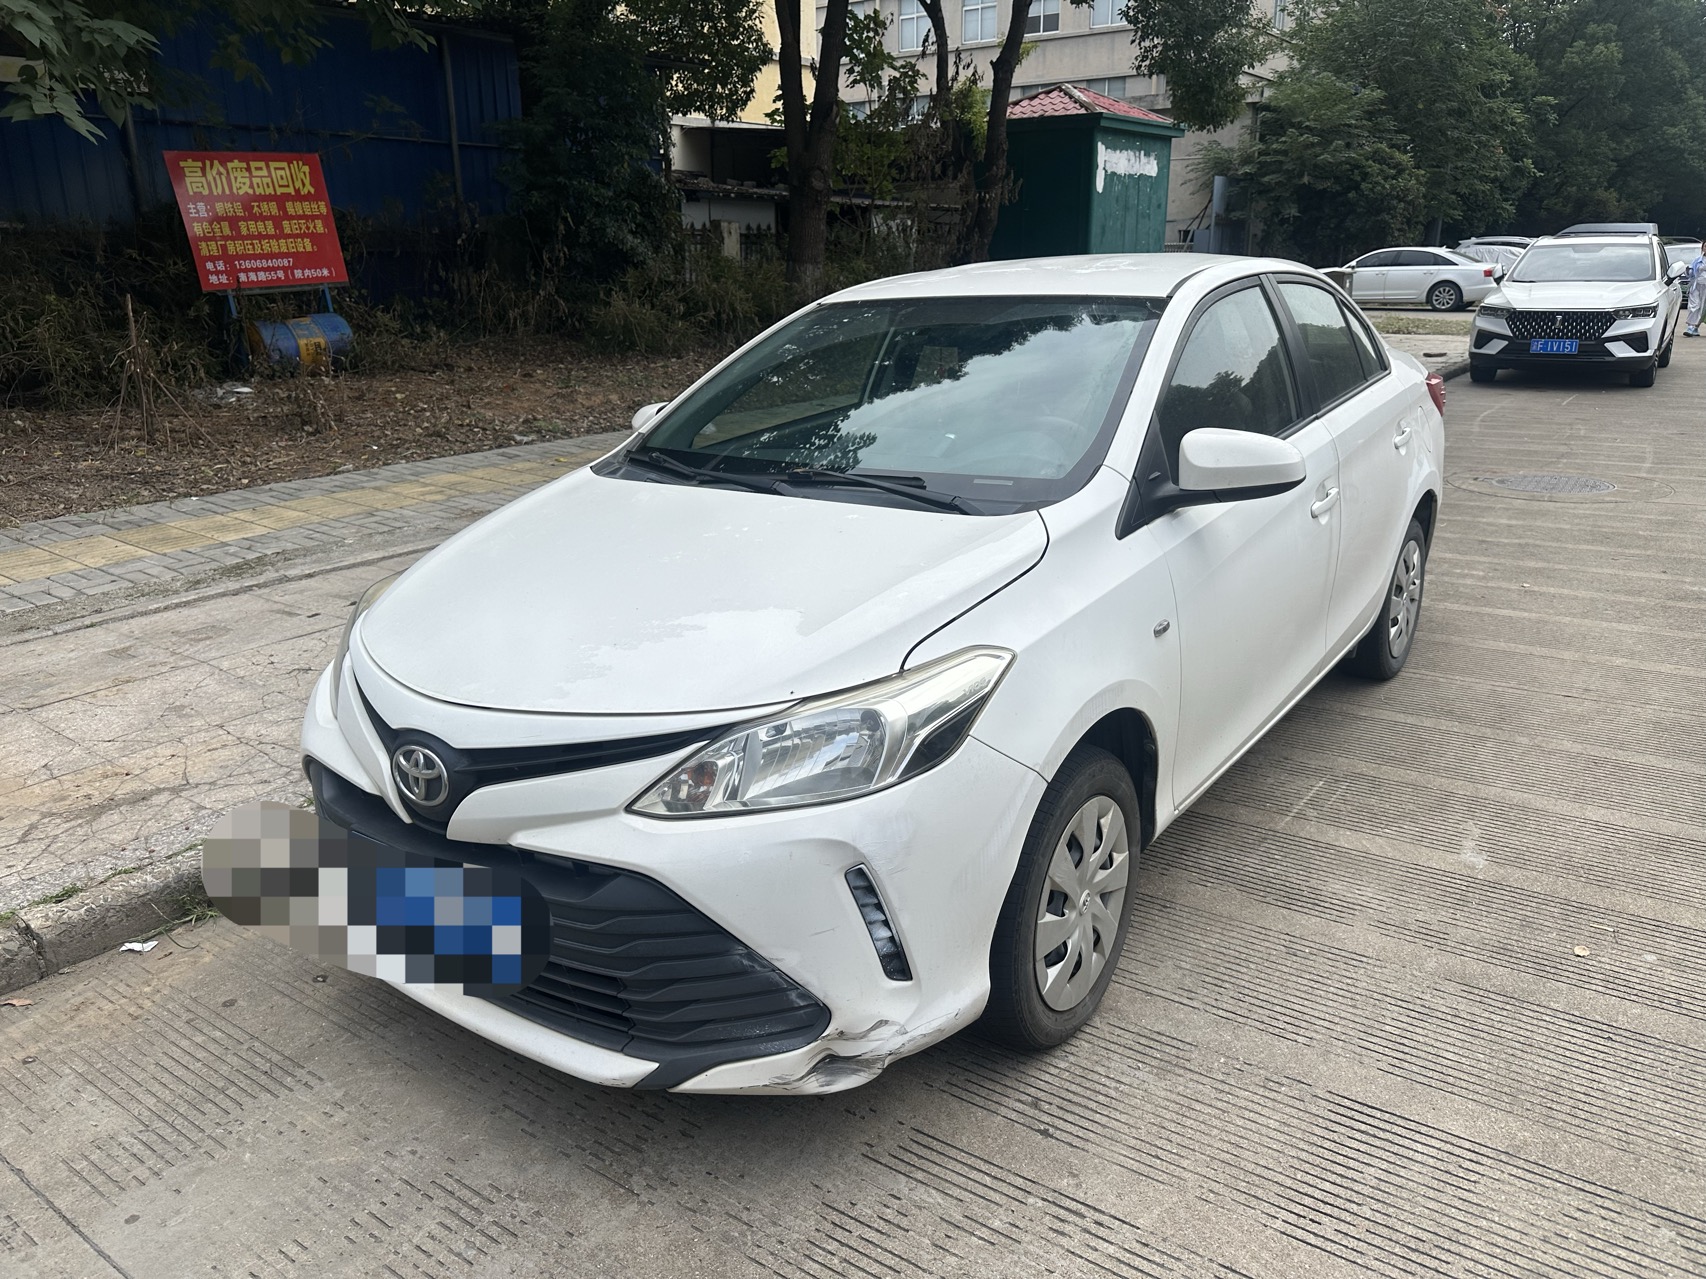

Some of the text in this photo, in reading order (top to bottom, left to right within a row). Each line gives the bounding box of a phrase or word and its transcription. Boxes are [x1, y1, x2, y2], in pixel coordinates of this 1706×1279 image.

[179, 158, 315, 196] 高价废品回收
[198, 237, 318, 257] 清理厂房积压及拆除废旧设备。
[205, 258, 294, 272] 电话：13606840087
